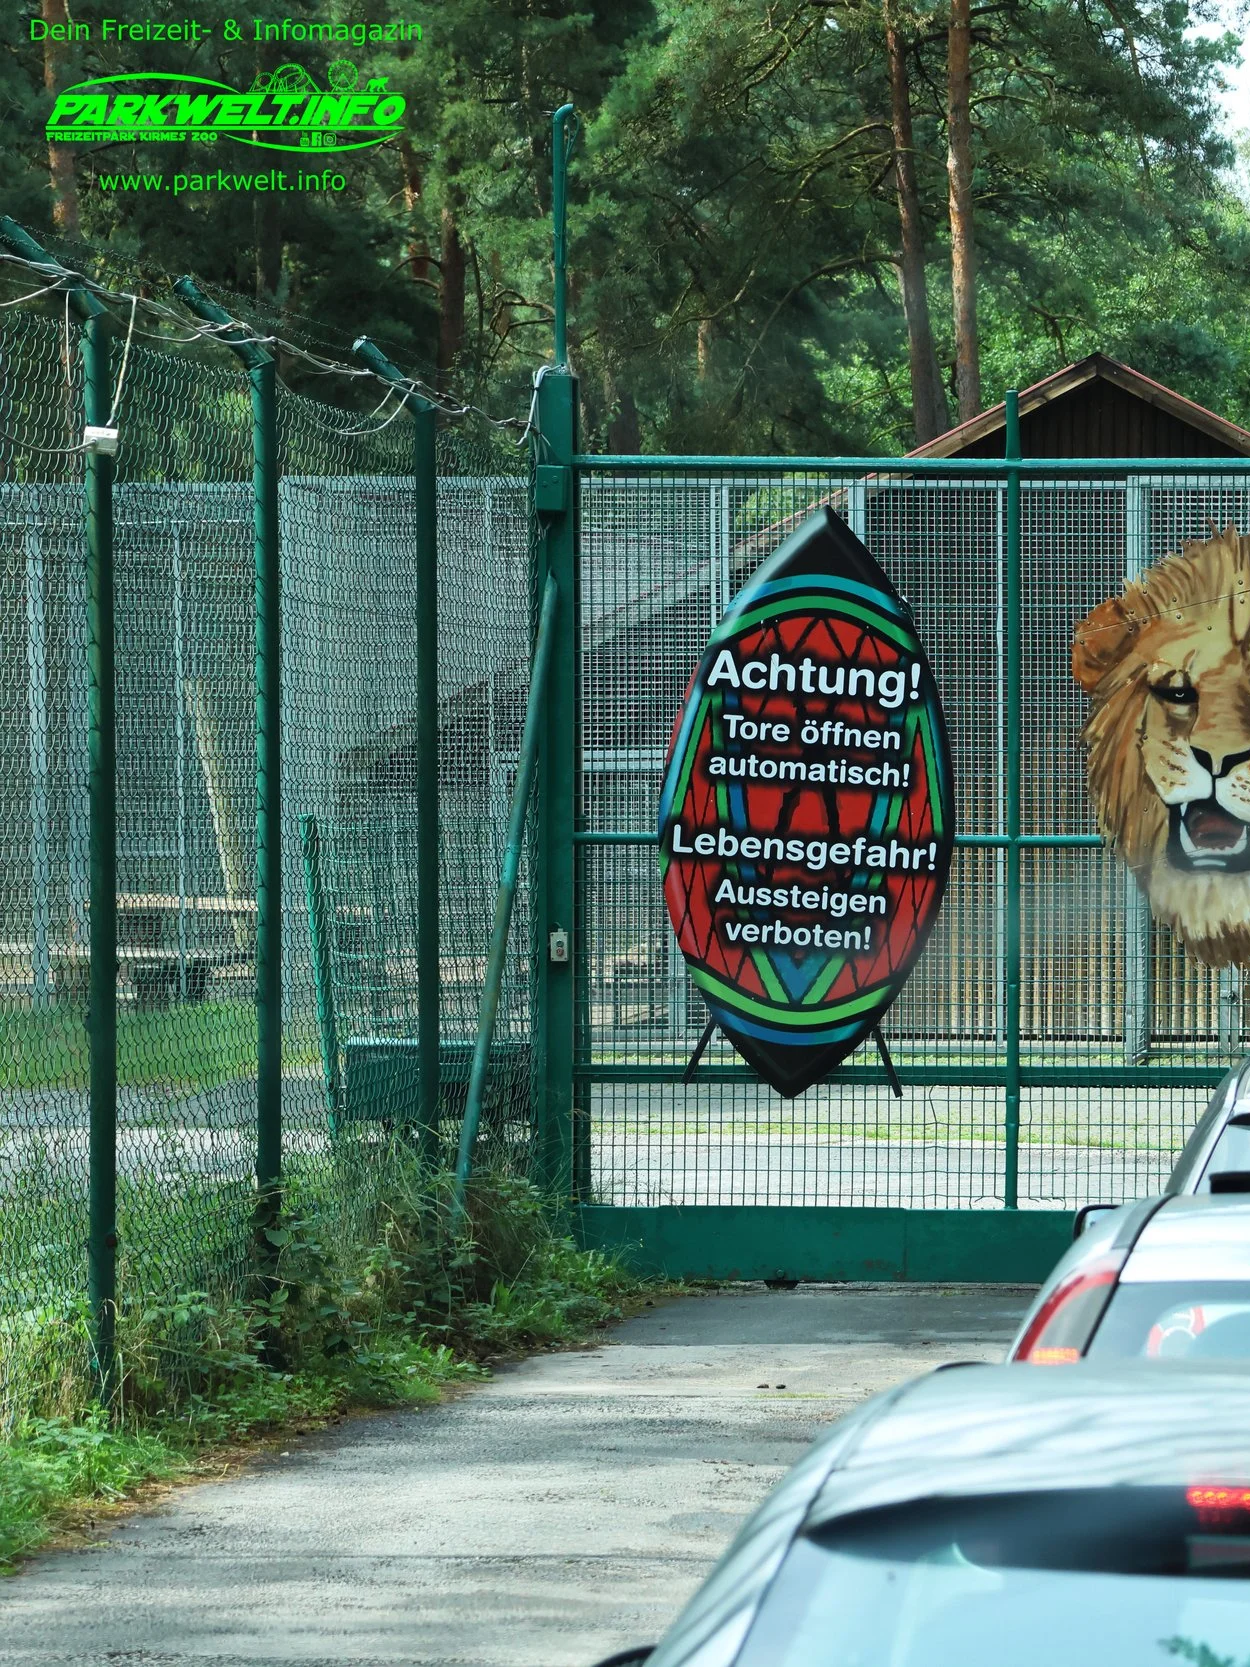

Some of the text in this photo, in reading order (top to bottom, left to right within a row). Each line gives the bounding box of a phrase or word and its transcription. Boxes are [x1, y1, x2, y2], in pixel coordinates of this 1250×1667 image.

[707, 650, 921, 709] Achtung!
[722, 714, 901, 750] Tore öffnen
[708, 754, 911, 788] automatisch!
[672, 824, 938, 871] Lebensgefahr!
[714, 878, 887, 917] Aussteigen
[725, 919, 872, 950] verboten!
